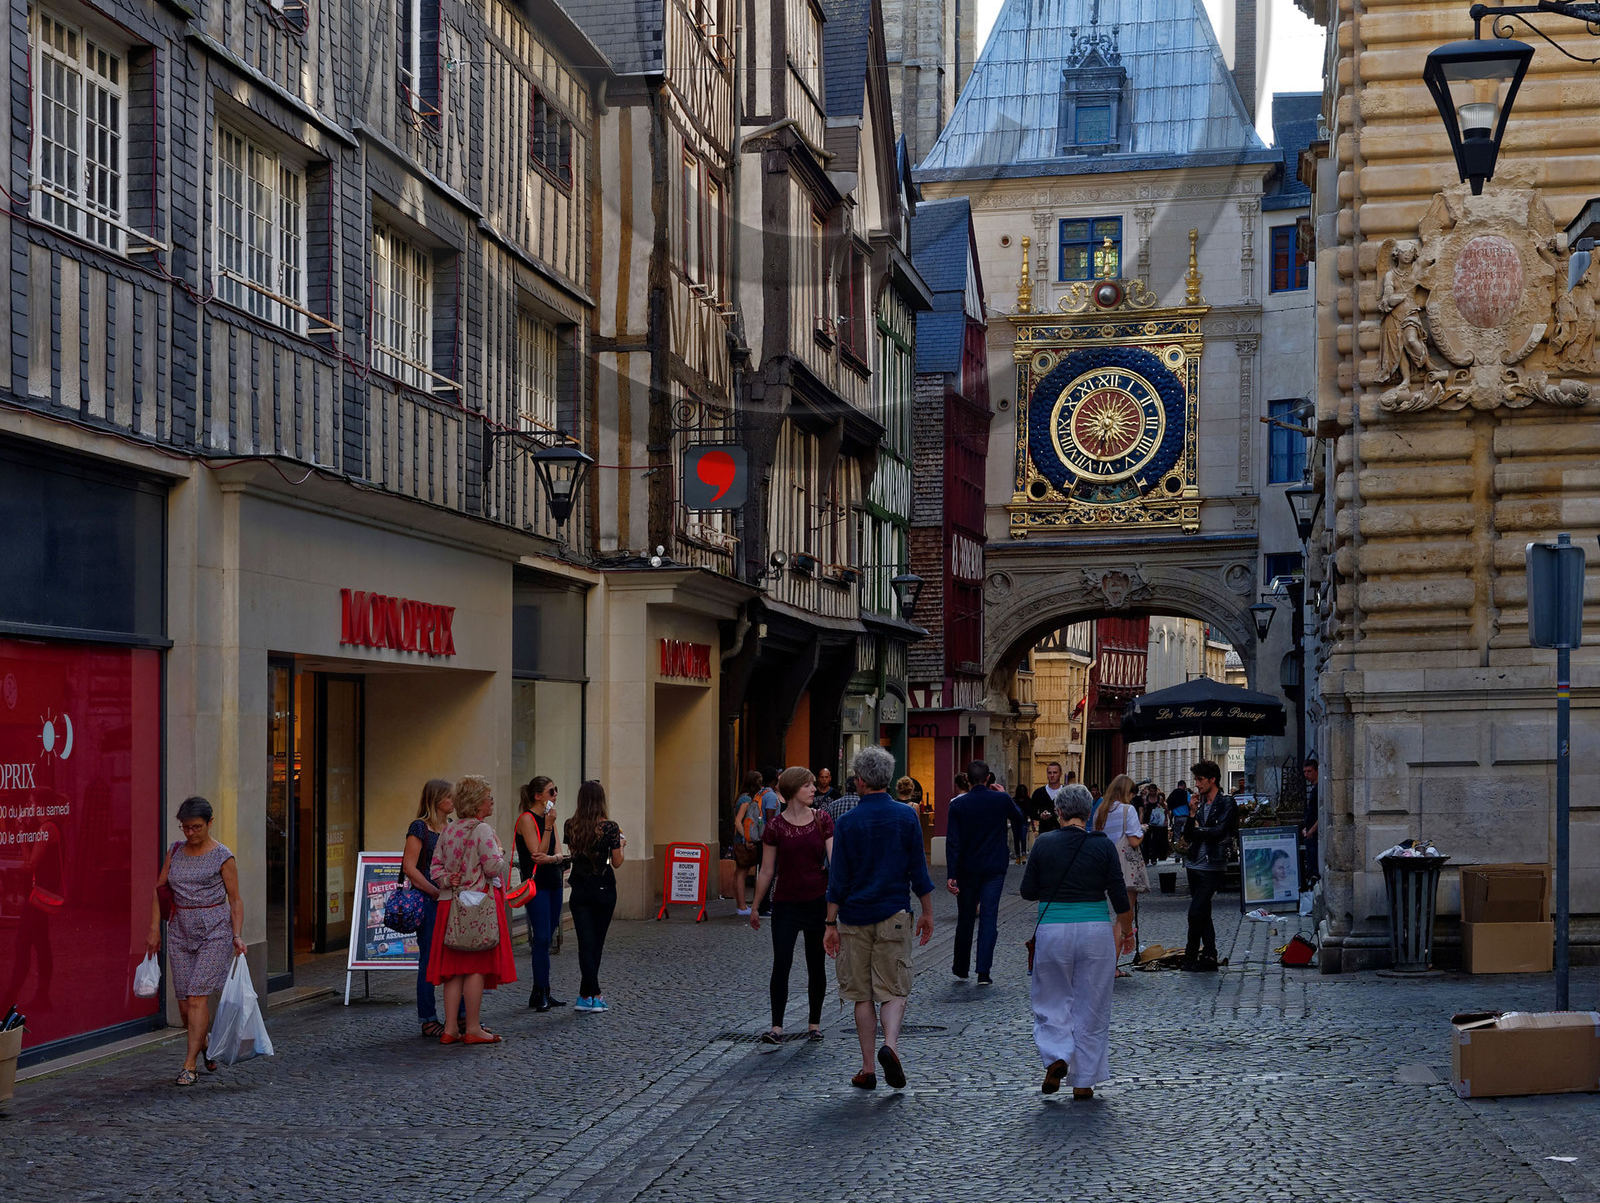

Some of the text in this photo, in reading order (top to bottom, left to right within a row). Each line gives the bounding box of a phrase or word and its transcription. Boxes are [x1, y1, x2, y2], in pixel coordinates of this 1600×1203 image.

[1098, 374, 1119, 387] XII
[1127, 380, 1135, 391] I
[1063, 396, 1078, 411] X
[1140, 395, 1153, 407] II
[1145, 416, 1159, 429] III
[1125, 456, 1137, 469] V
[339, 588, 456, 657] MONOPRIX
[660, 638, 712, 679] MONOPRIX
[1155, 706, 1267, 722] Les Fleurs du Passage
[8, 804, 18, 819] du
[19, 803, 35, 818] lundi
[36, 806, 45, 817] au
[46, 802, 70, 816] samedi
[8, 830, 15, 844] le
[16, 829, 49, 843] dimanche
